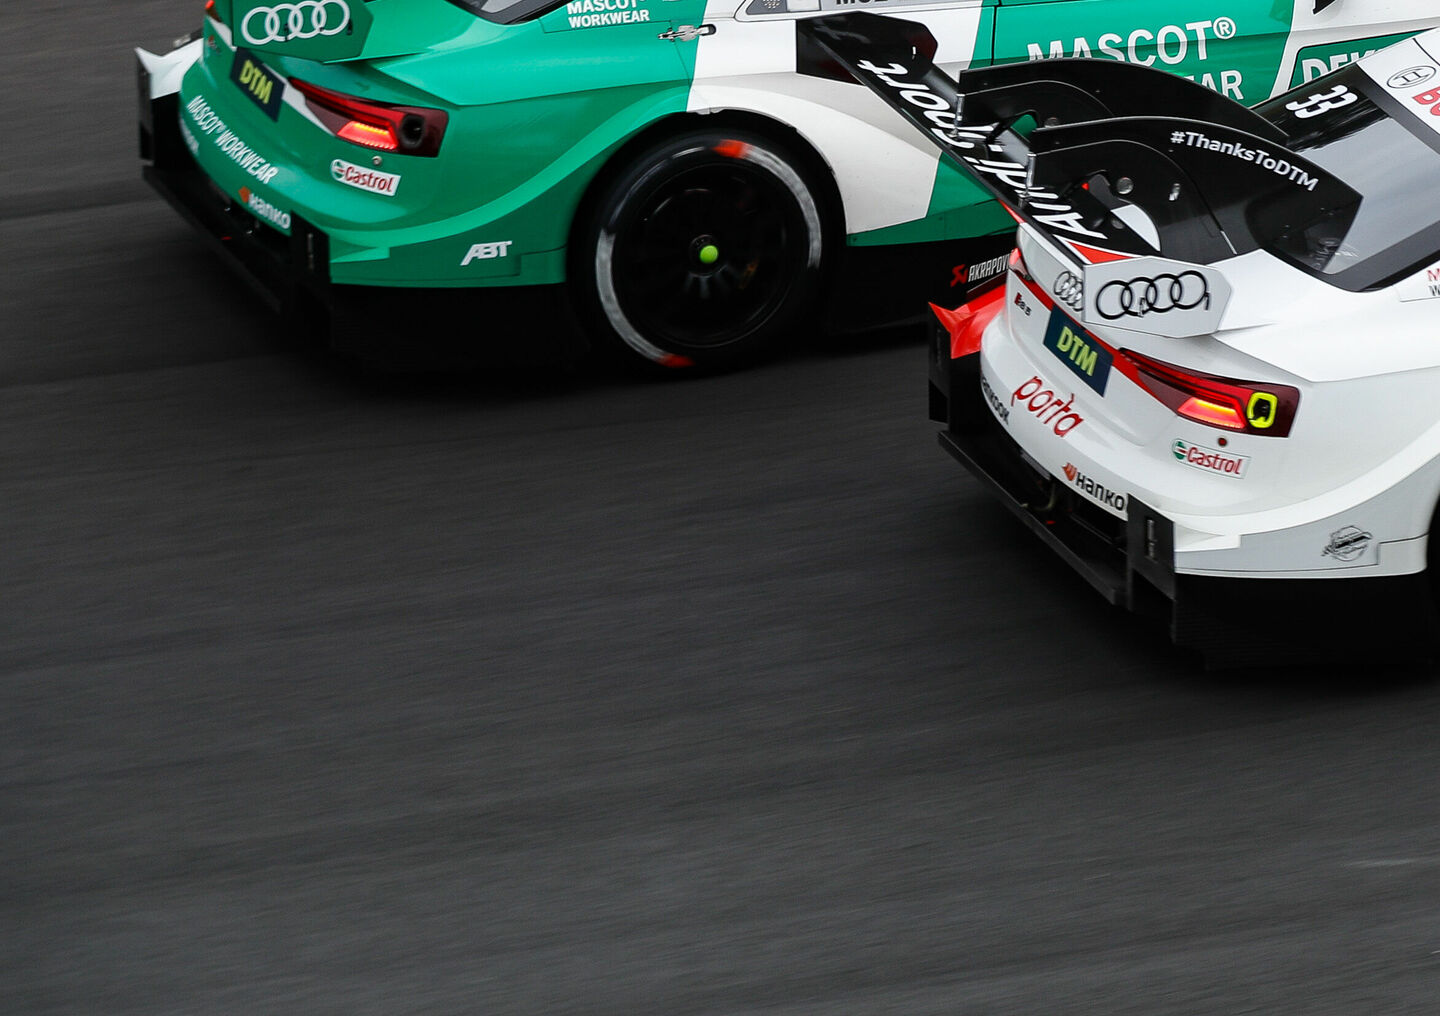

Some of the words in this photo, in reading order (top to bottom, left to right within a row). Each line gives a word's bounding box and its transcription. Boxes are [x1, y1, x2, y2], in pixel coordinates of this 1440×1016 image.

[568, 9, 650, 28] WORKWEAR
[238, 59, 274, 105] DTM
[1285, 85, 1358, 119] 33
[215, 129, 279, 184] WORKWEAR
[1170, 129, 1319, 192] #ThanksToDTM
[343, 163, 398, 194] Castrol
[460, 240, 513, 266] ABT
[1056, 326, 1098, 377] DTM
[1010, 376, 1085, 437] porta
[1185, 446, 1243, 476] Castrol
[1076, 471, 1126, 512] Hanko
